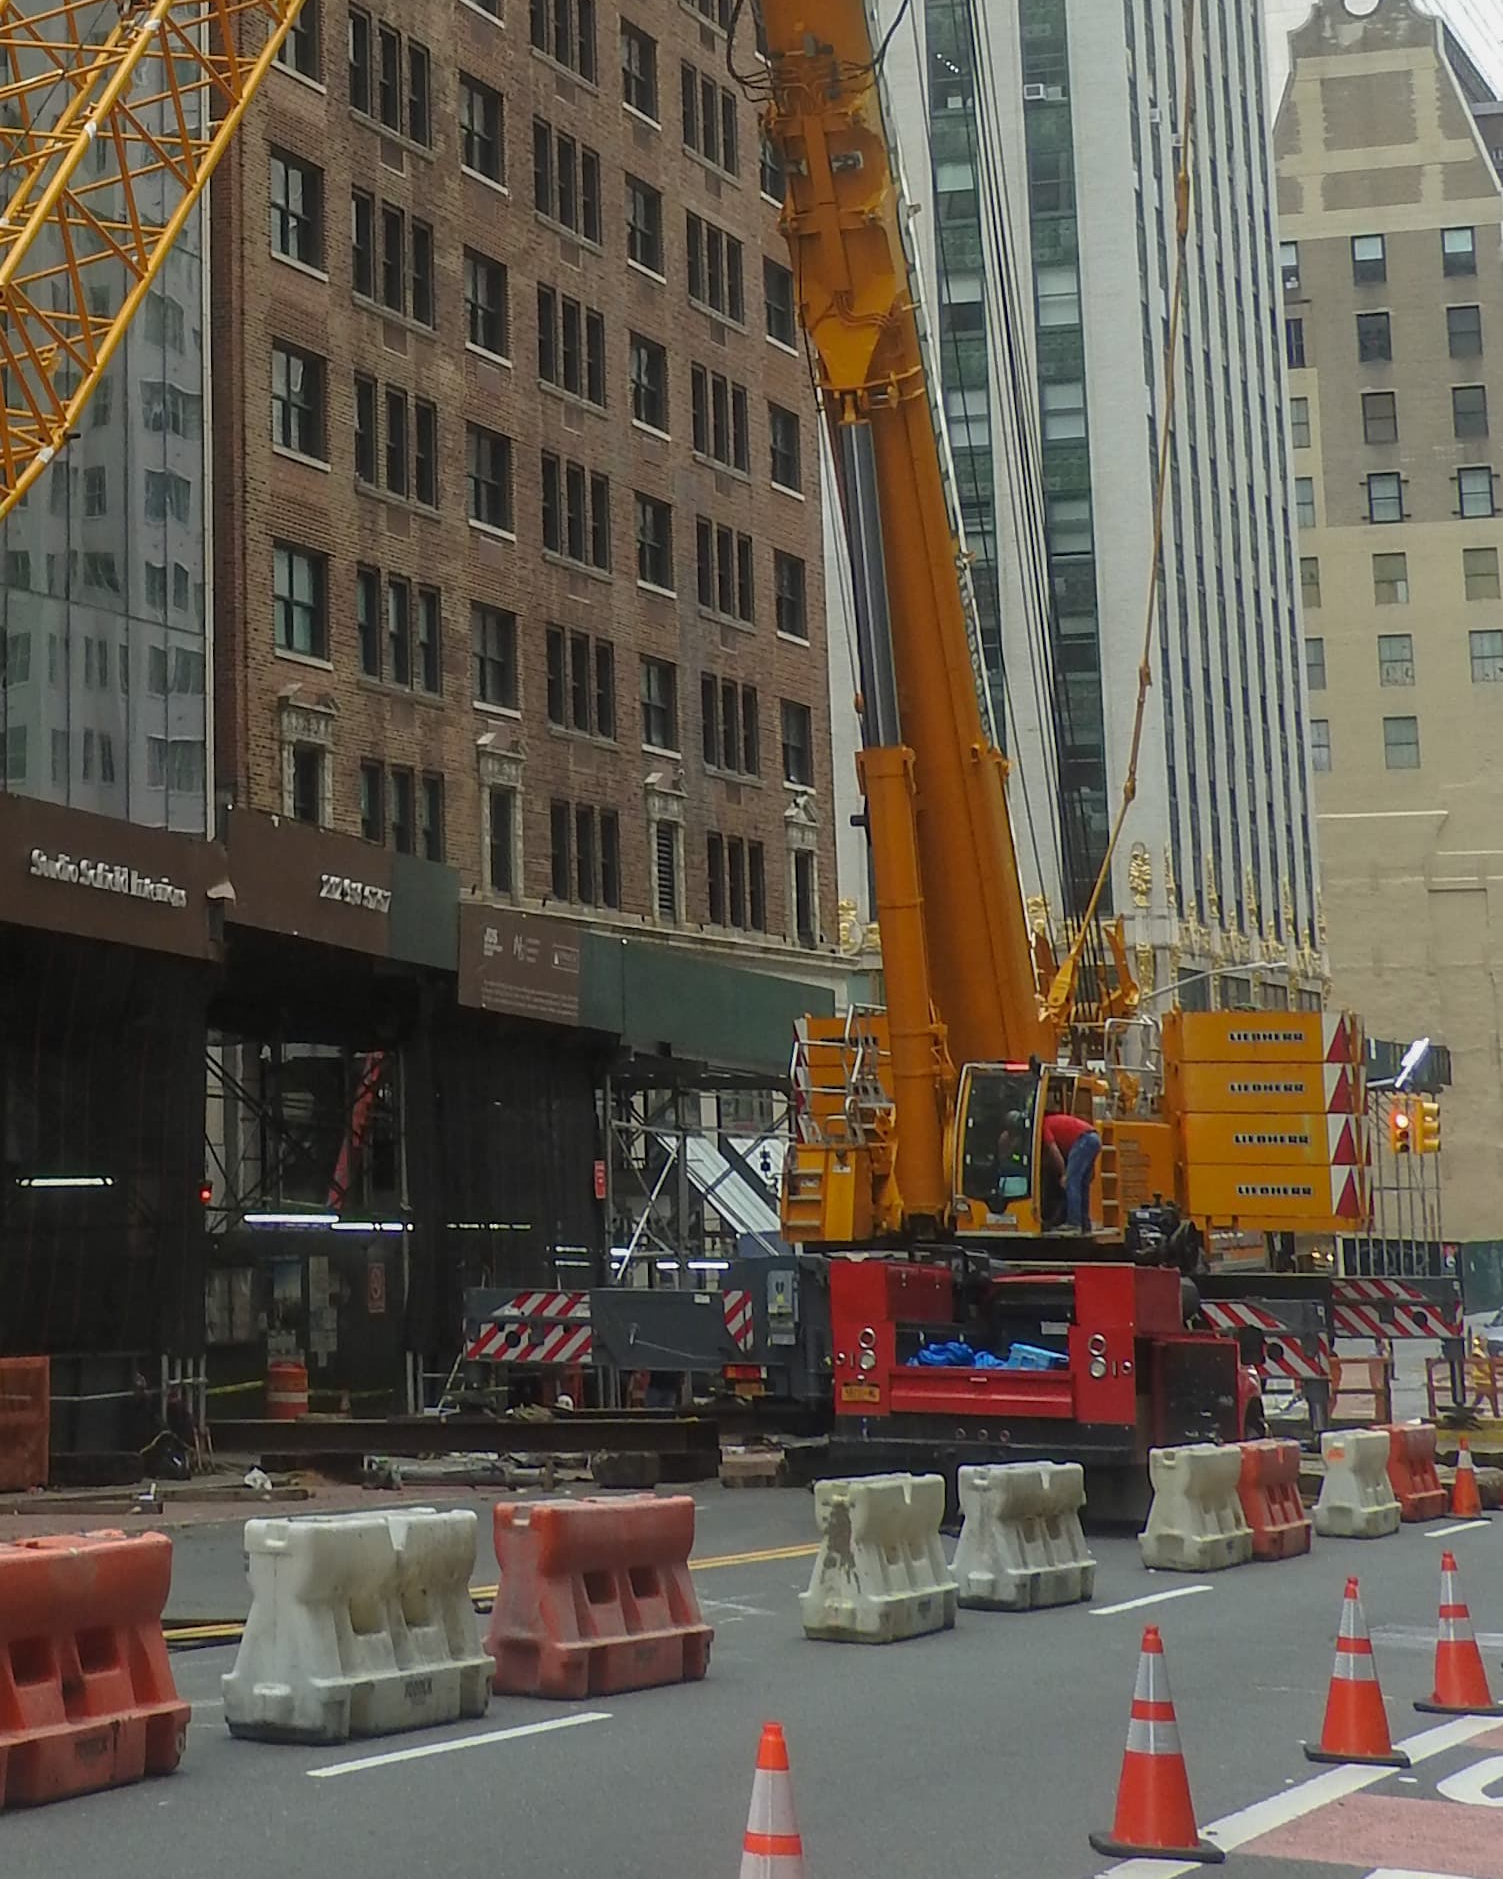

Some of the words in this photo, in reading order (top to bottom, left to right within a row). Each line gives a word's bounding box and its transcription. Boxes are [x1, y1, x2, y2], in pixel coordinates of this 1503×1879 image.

[1230, 1032, 1304, 1042] LIEBHERR
[1230, 1083, 1305, 1093] LIEBHERR
[1234, 1134, 1309, 1144] LIEBHERR
[1238, 1186, 1313, 1196] LIEBHERR
